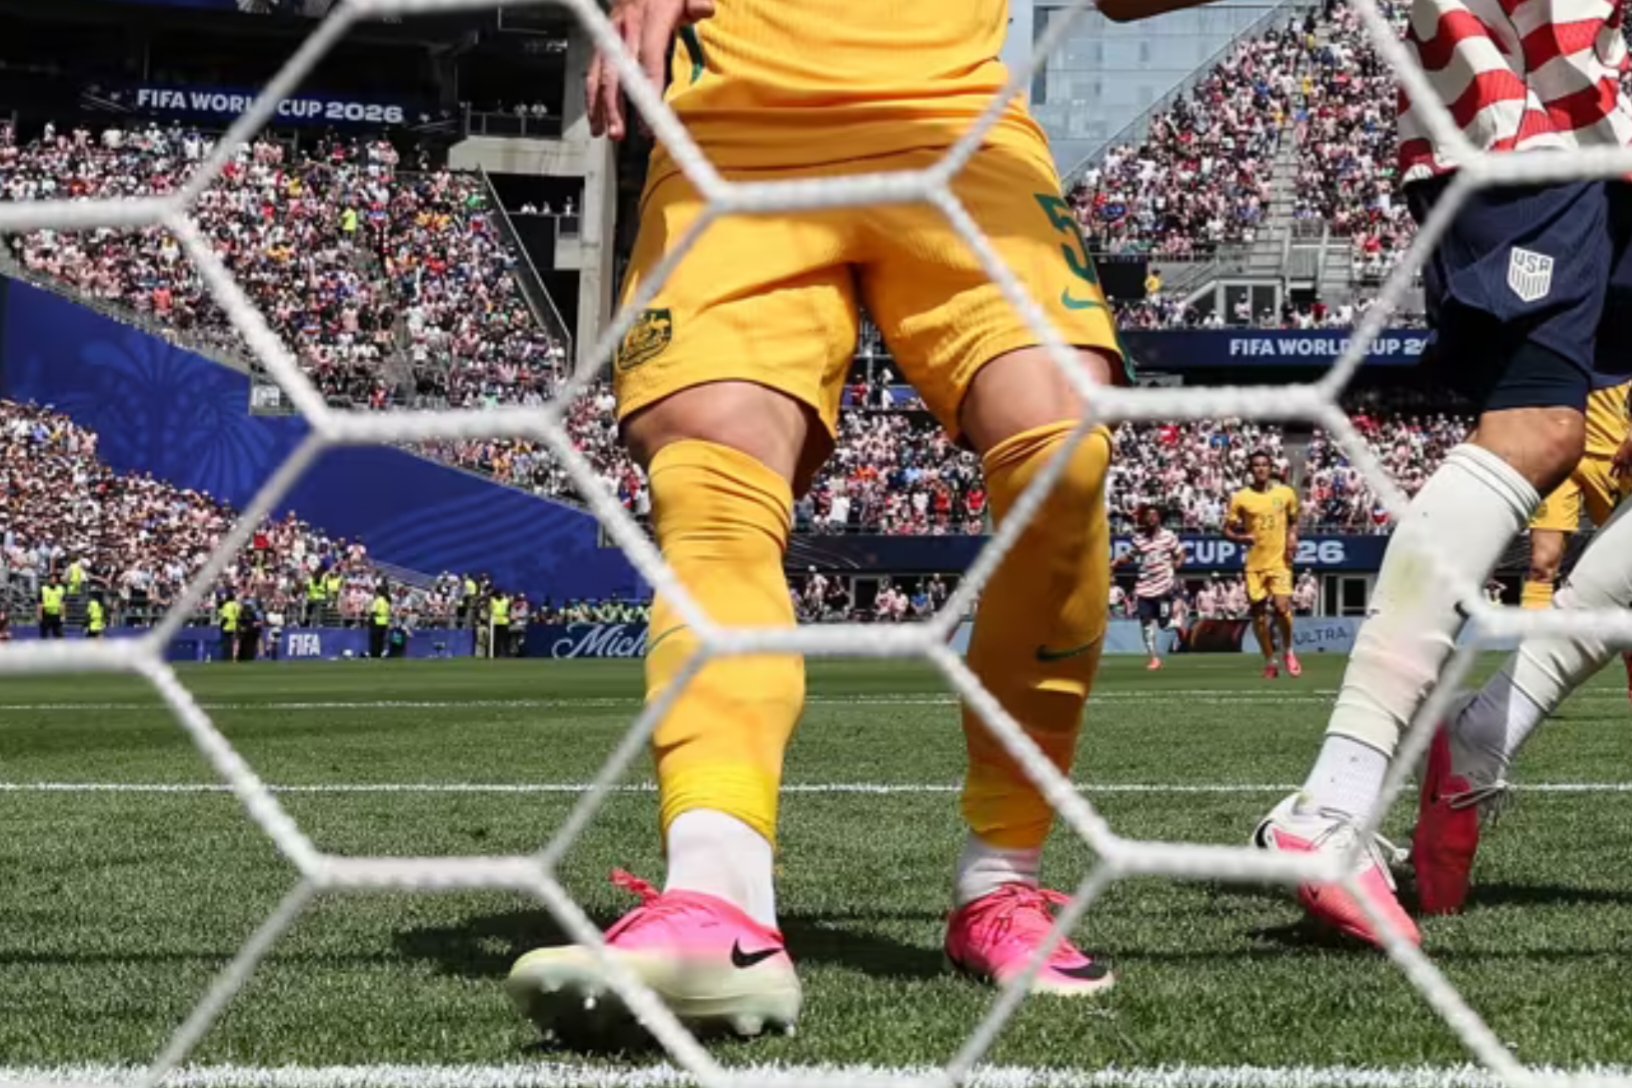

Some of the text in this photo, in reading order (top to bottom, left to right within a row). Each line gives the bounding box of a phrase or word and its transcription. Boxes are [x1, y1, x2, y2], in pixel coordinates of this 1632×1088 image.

[138, 88, 186, 110] FIFA
[278, 99, 322, 118] CUP
[325, 101, 404, 124] 2026
[1033, 192, 1098, 284] 5
[1514, 251, 1551, 274] USA
[1229, 338, 1276, 356] FIFA
[1362, 338, 1400, 356] UP
[287, 633, 321, 656] FIFA
